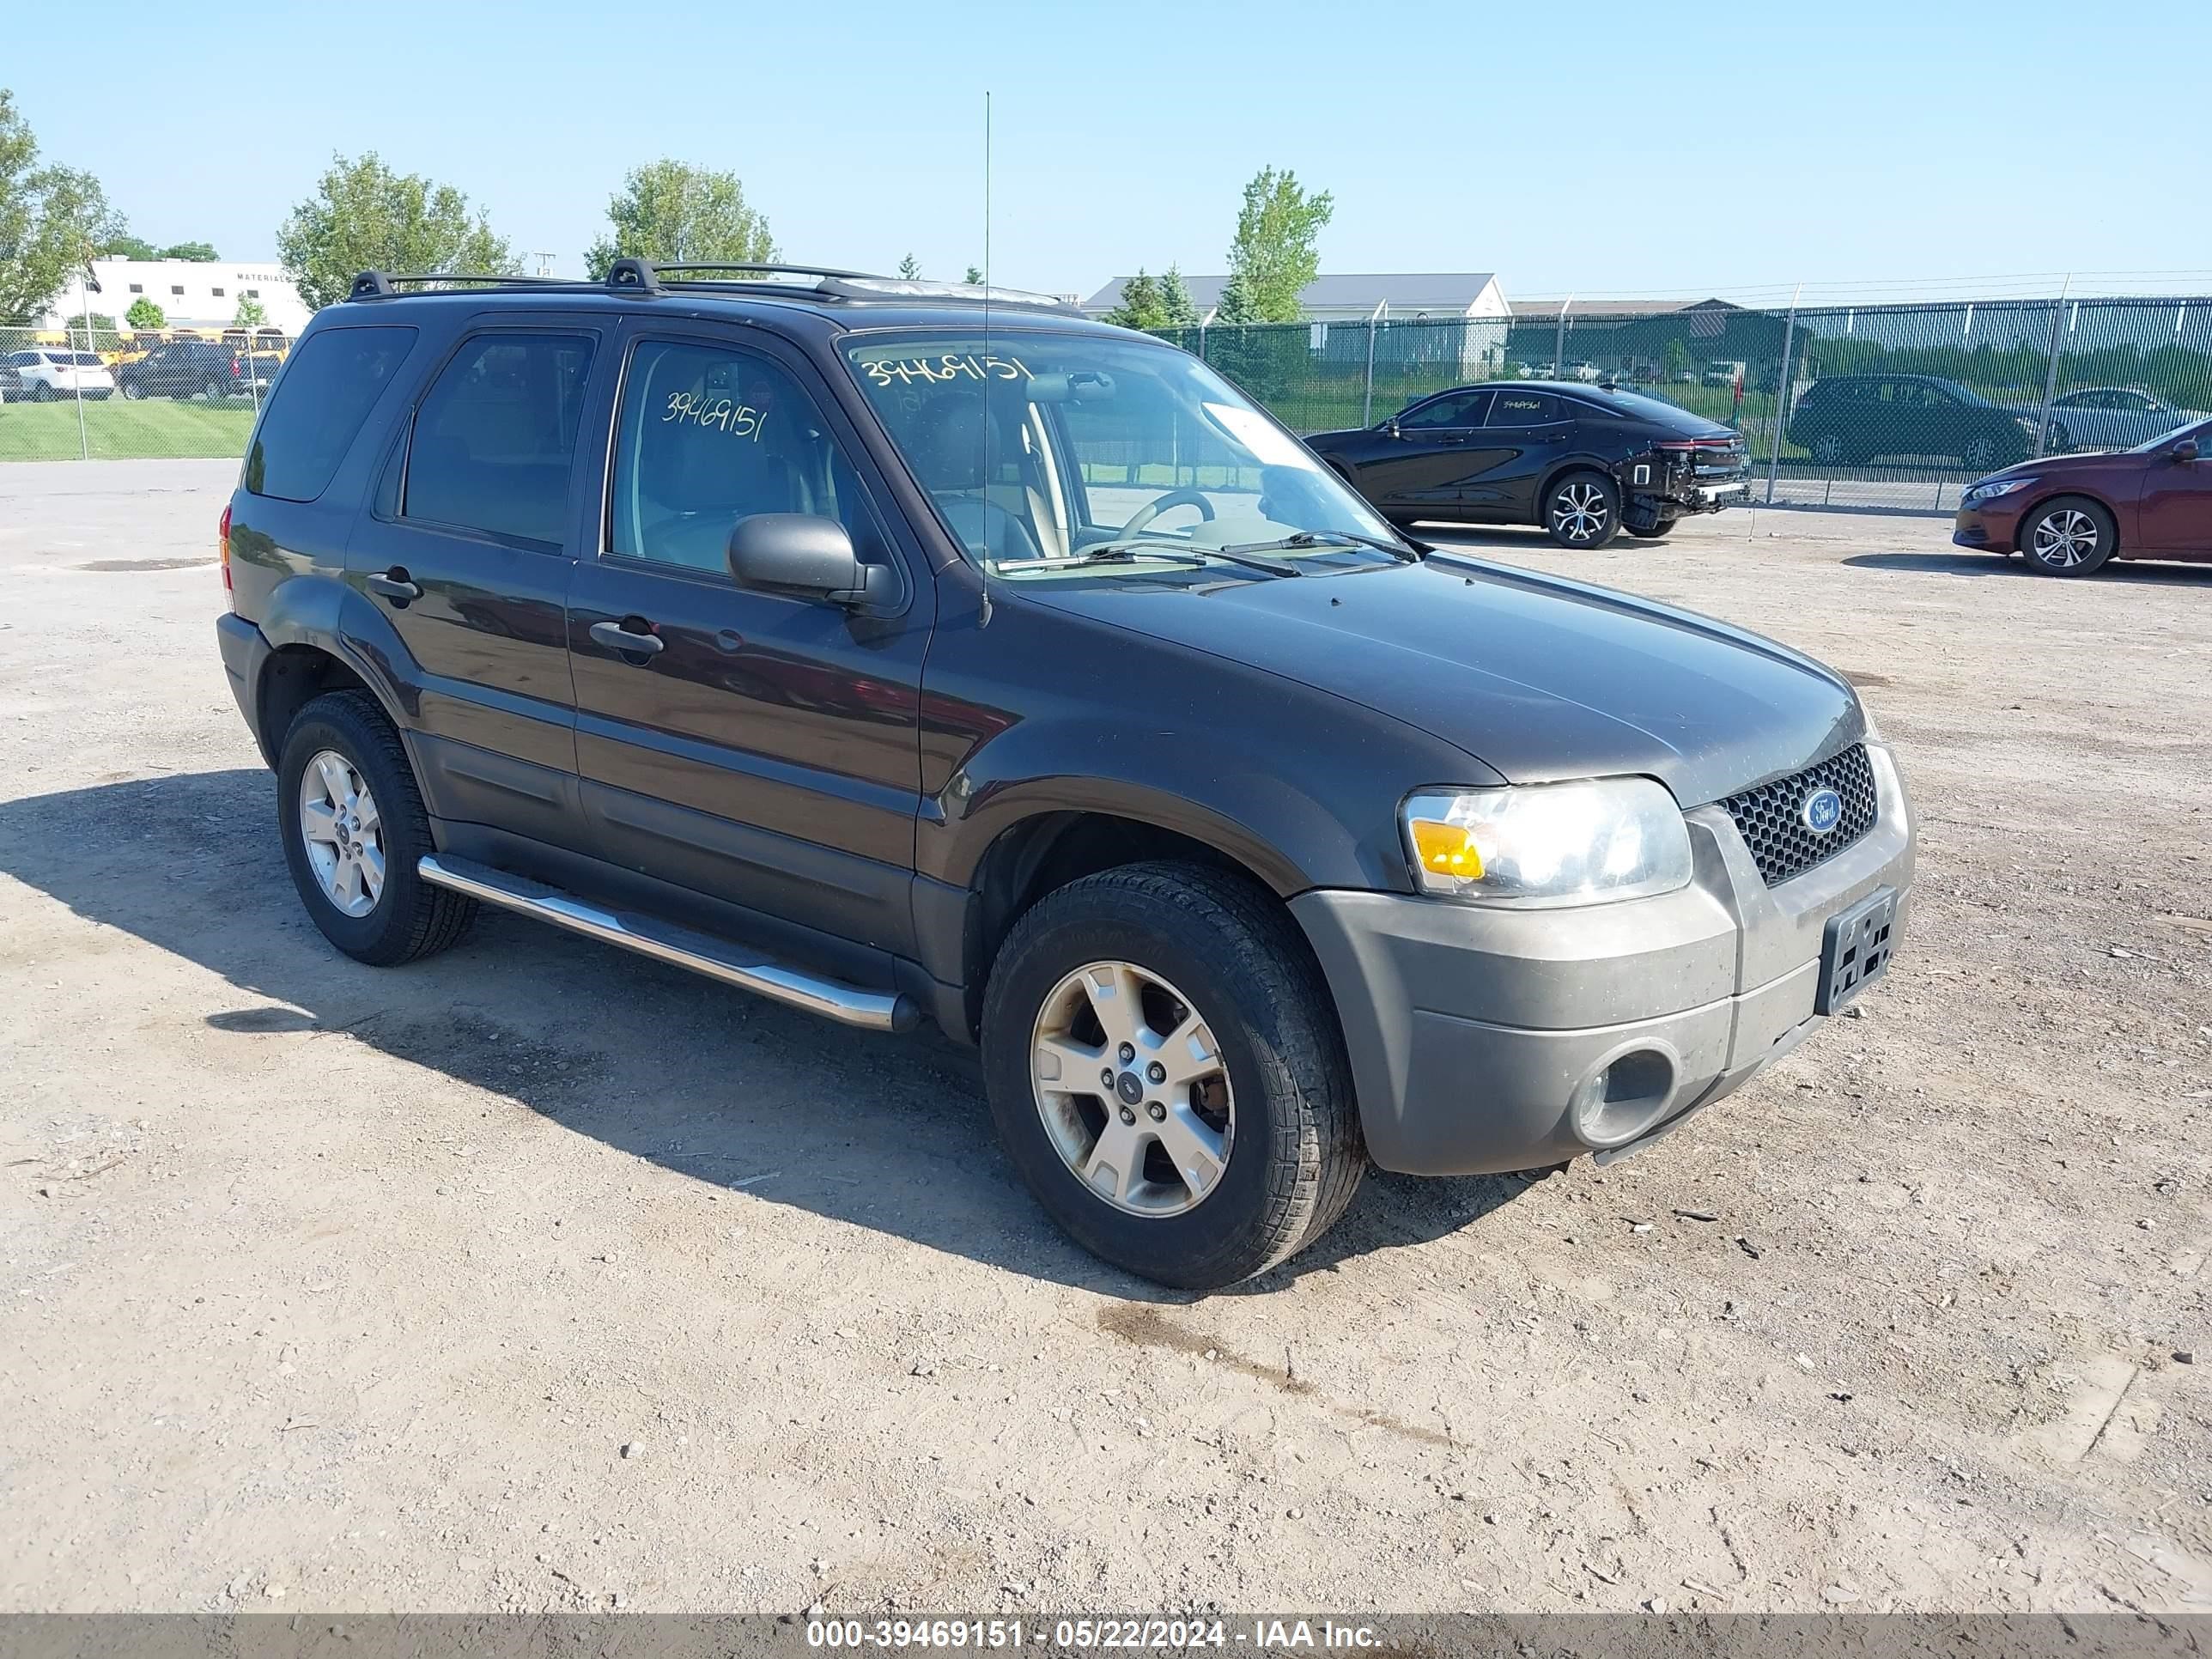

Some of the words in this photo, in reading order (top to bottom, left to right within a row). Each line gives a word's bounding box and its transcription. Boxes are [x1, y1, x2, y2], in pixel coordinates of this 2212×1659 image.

[862, 356, 1036, 386] 39469151
[662, 392, 767, 442] 39469151
[1815, 798, 1836, 825] Ford
